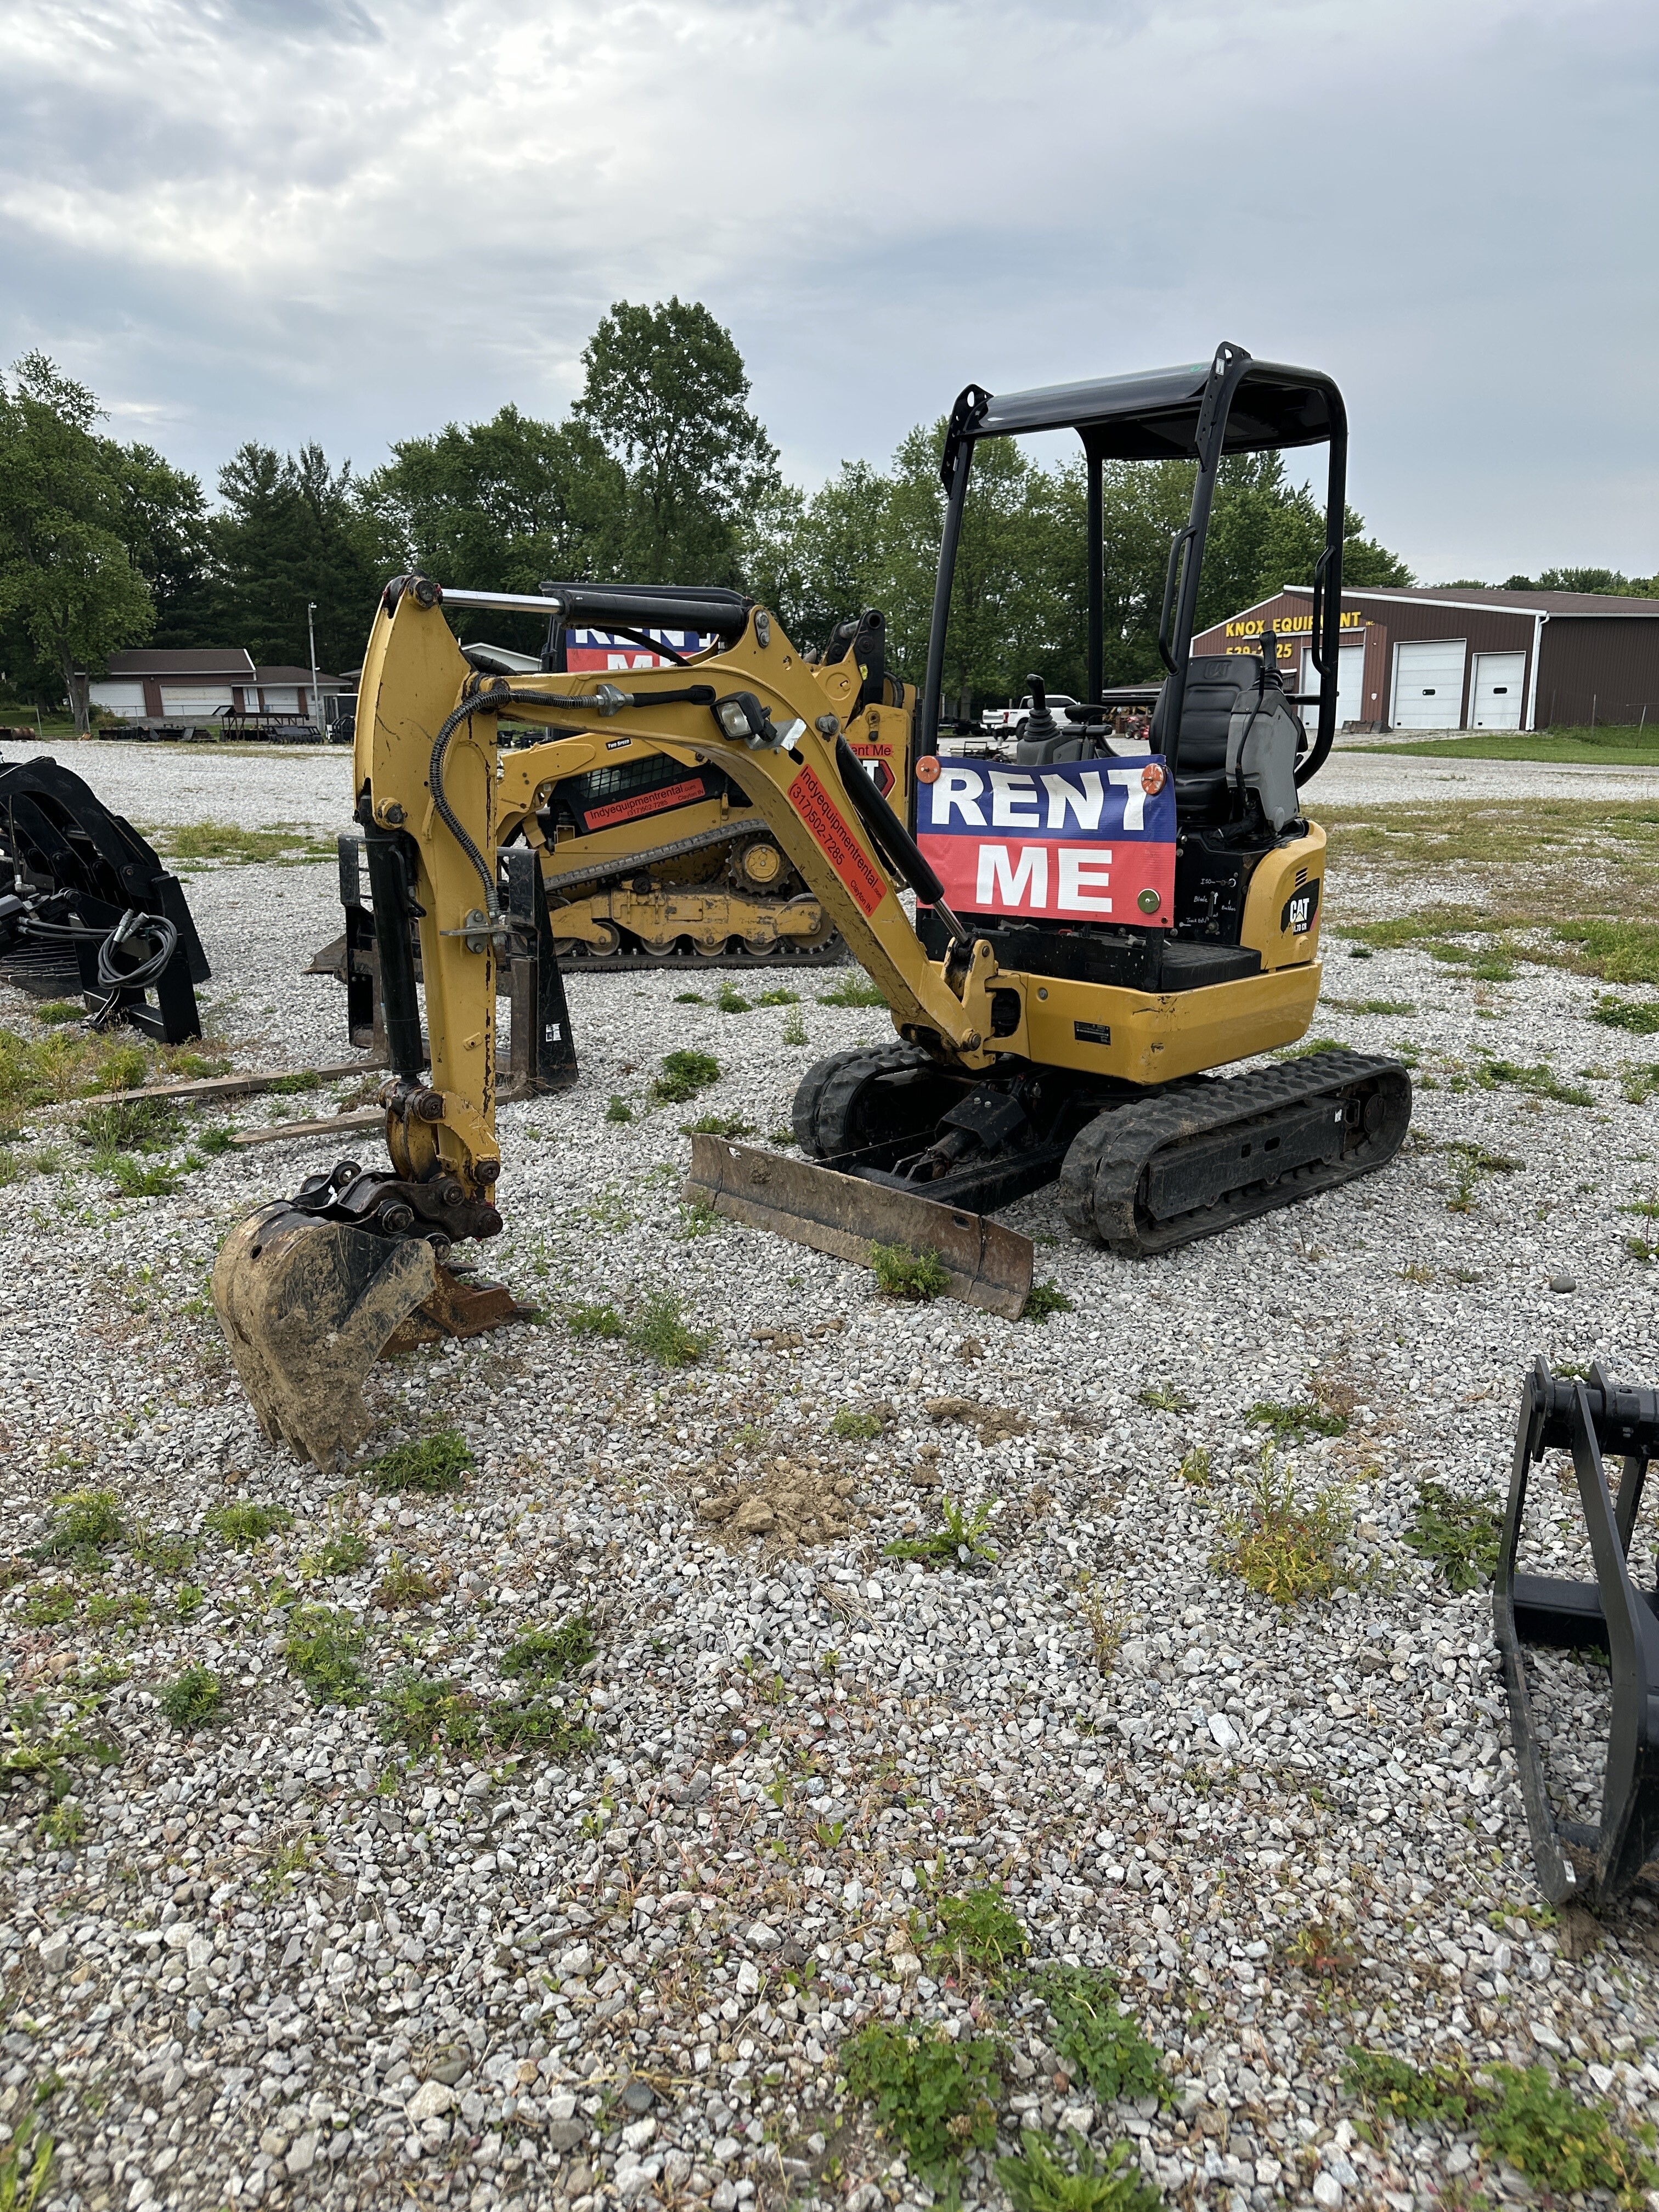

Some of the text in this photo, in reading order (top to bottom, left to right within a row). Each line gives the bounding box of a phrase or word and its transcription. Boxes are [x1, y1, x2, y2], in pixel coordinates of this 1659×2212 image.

[1226, 620, 1265, 637] KNOX
[1272, 612, 1361, 633] EQUIPNT
[851, 745, 891, 755] ent Me
[628, 801, 668, 816] (317)502-7285
[932, 768, 1148, 830] RENT
[789, 783, 873, 913] (317)502-7285 Clayton IN
[976, 845, 1112, 912] ME
[1290, 898, 1310, 923] CAT
